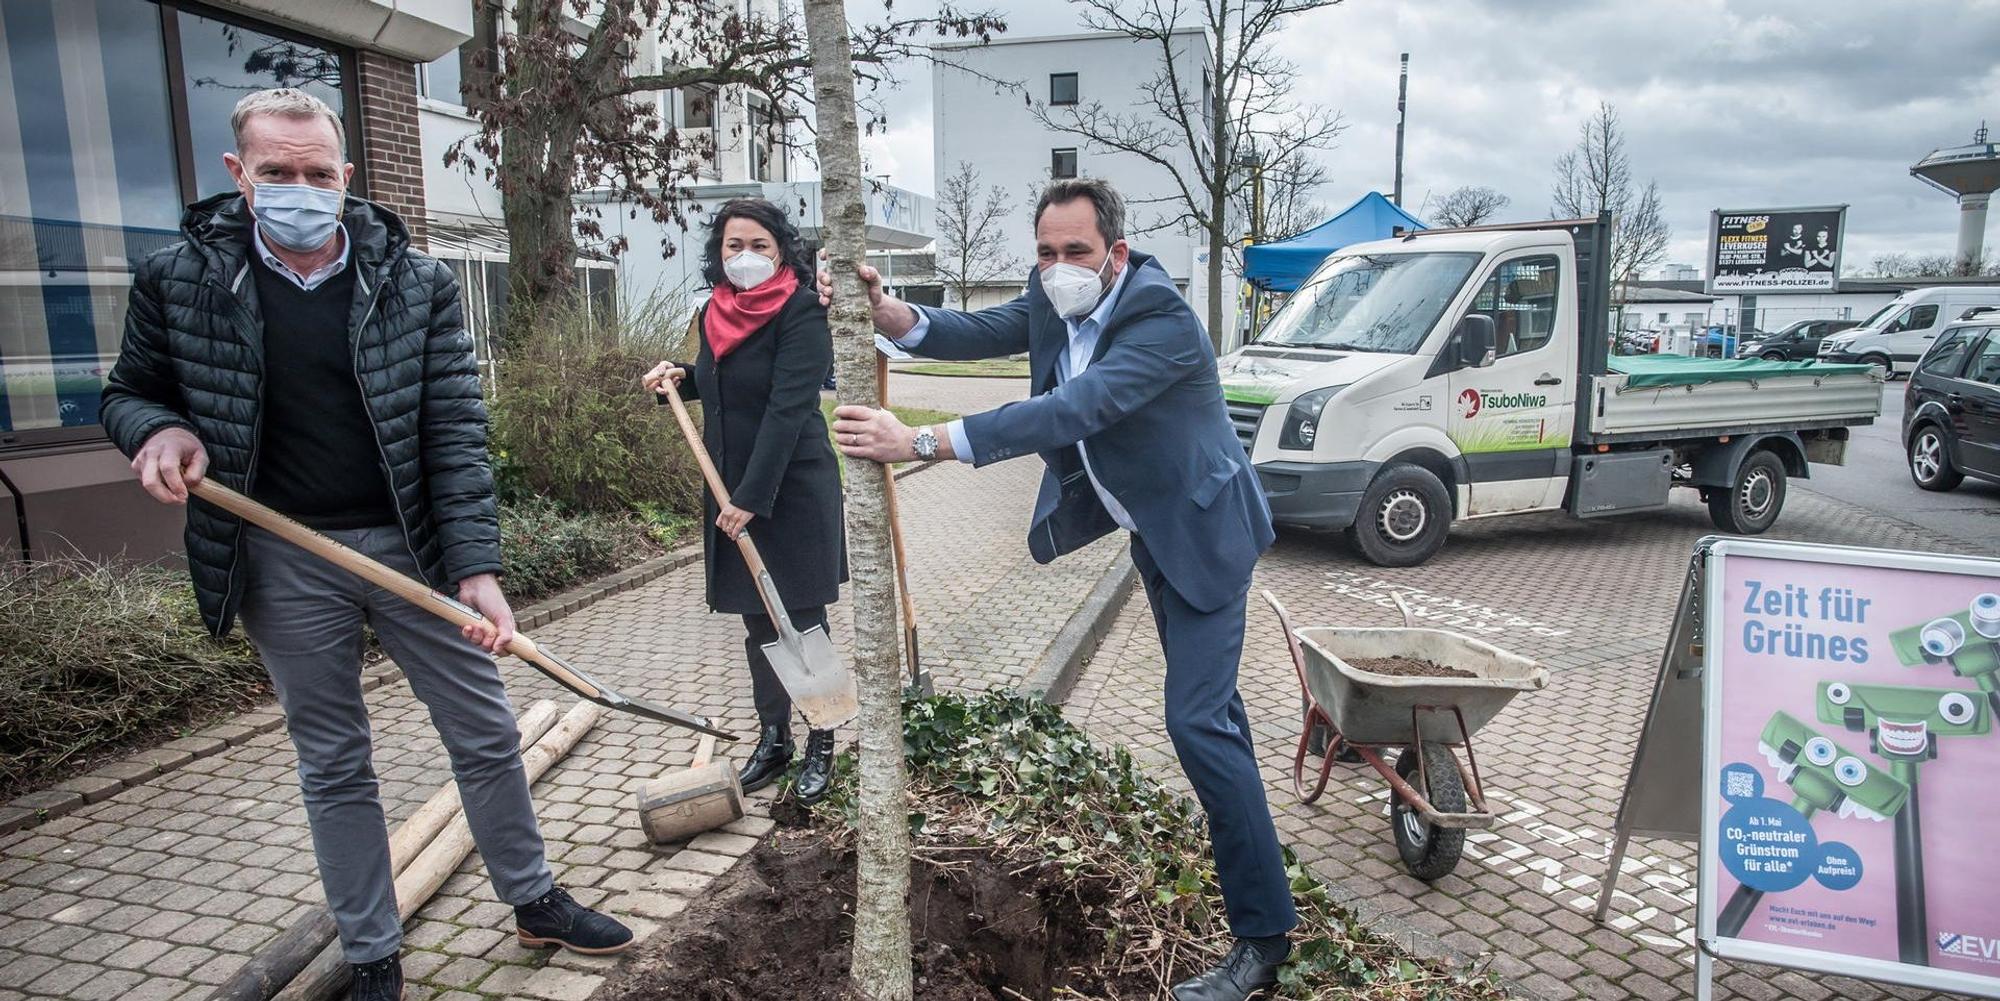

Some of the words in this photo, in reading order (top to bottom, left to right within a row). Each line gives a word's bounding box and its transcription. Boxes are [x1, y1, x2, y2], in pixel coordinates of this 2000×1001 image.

[1722, 215, 1769, 224] FITNESS
[1720, 242, 1767, 250] LEVERKUSEN
[1717, 279, 1830, 287] www.FITNESS-POLIZEI.de
[1480, 393, 1546, 409] TsuboNiwa
[1743, 580, 1809, 618] Zeit
[1818, 587, 1872, 624] für
[1743, 619, 1869, 664] Grünes
[1749, 816, 1759, 826] Ab
[1768, 817, 1782, 827] Mai
[1736, 843, 1799, 858] Grünstrom
[1744, 859, 1761, 872] für
[1826, 856, 1848, 865] Ohne
[1818, 865, 1856, 877] Aufpreis!
[1769, 905, 1789, 913] Macht
[1807, 910, 1818, 918] mit
[1833, 913, 1844, 921] auf
